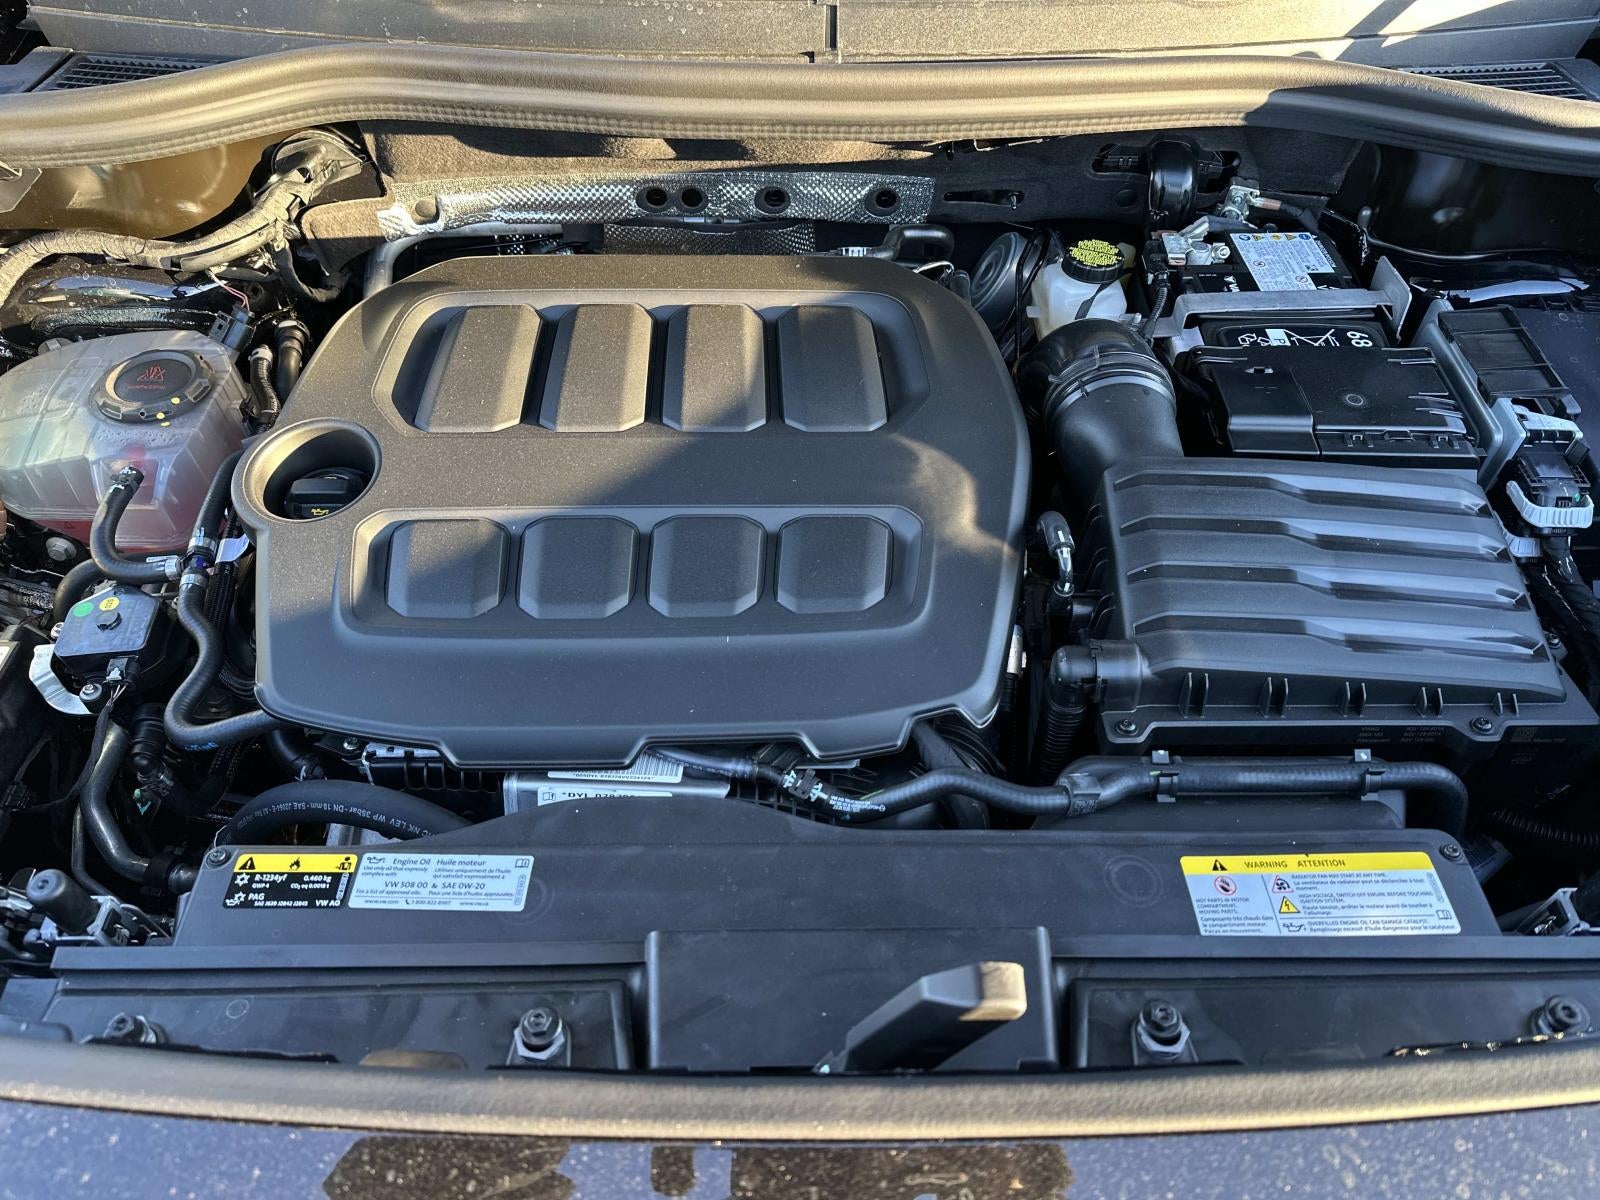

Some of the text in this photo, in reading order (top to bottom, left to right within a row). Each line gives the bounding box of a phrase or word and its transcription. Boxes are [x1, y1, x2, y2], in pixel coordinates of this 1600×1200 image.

[1346, 330, 1373, 347] 68
[294, 802, 306, 810] SAE
[333, 804, 344, 813] DN
[349, 806, 371, 819] 35bar
[373, 813, 387, 823] WP
[389, 818, 406, 830] LEV
[393, 858, 418, 866] Engine
[1297, 859, 1346, 867] ATTENTION
[254, 873, 288, 882] R-1234yf
[323, 875, 332, 883] kg
